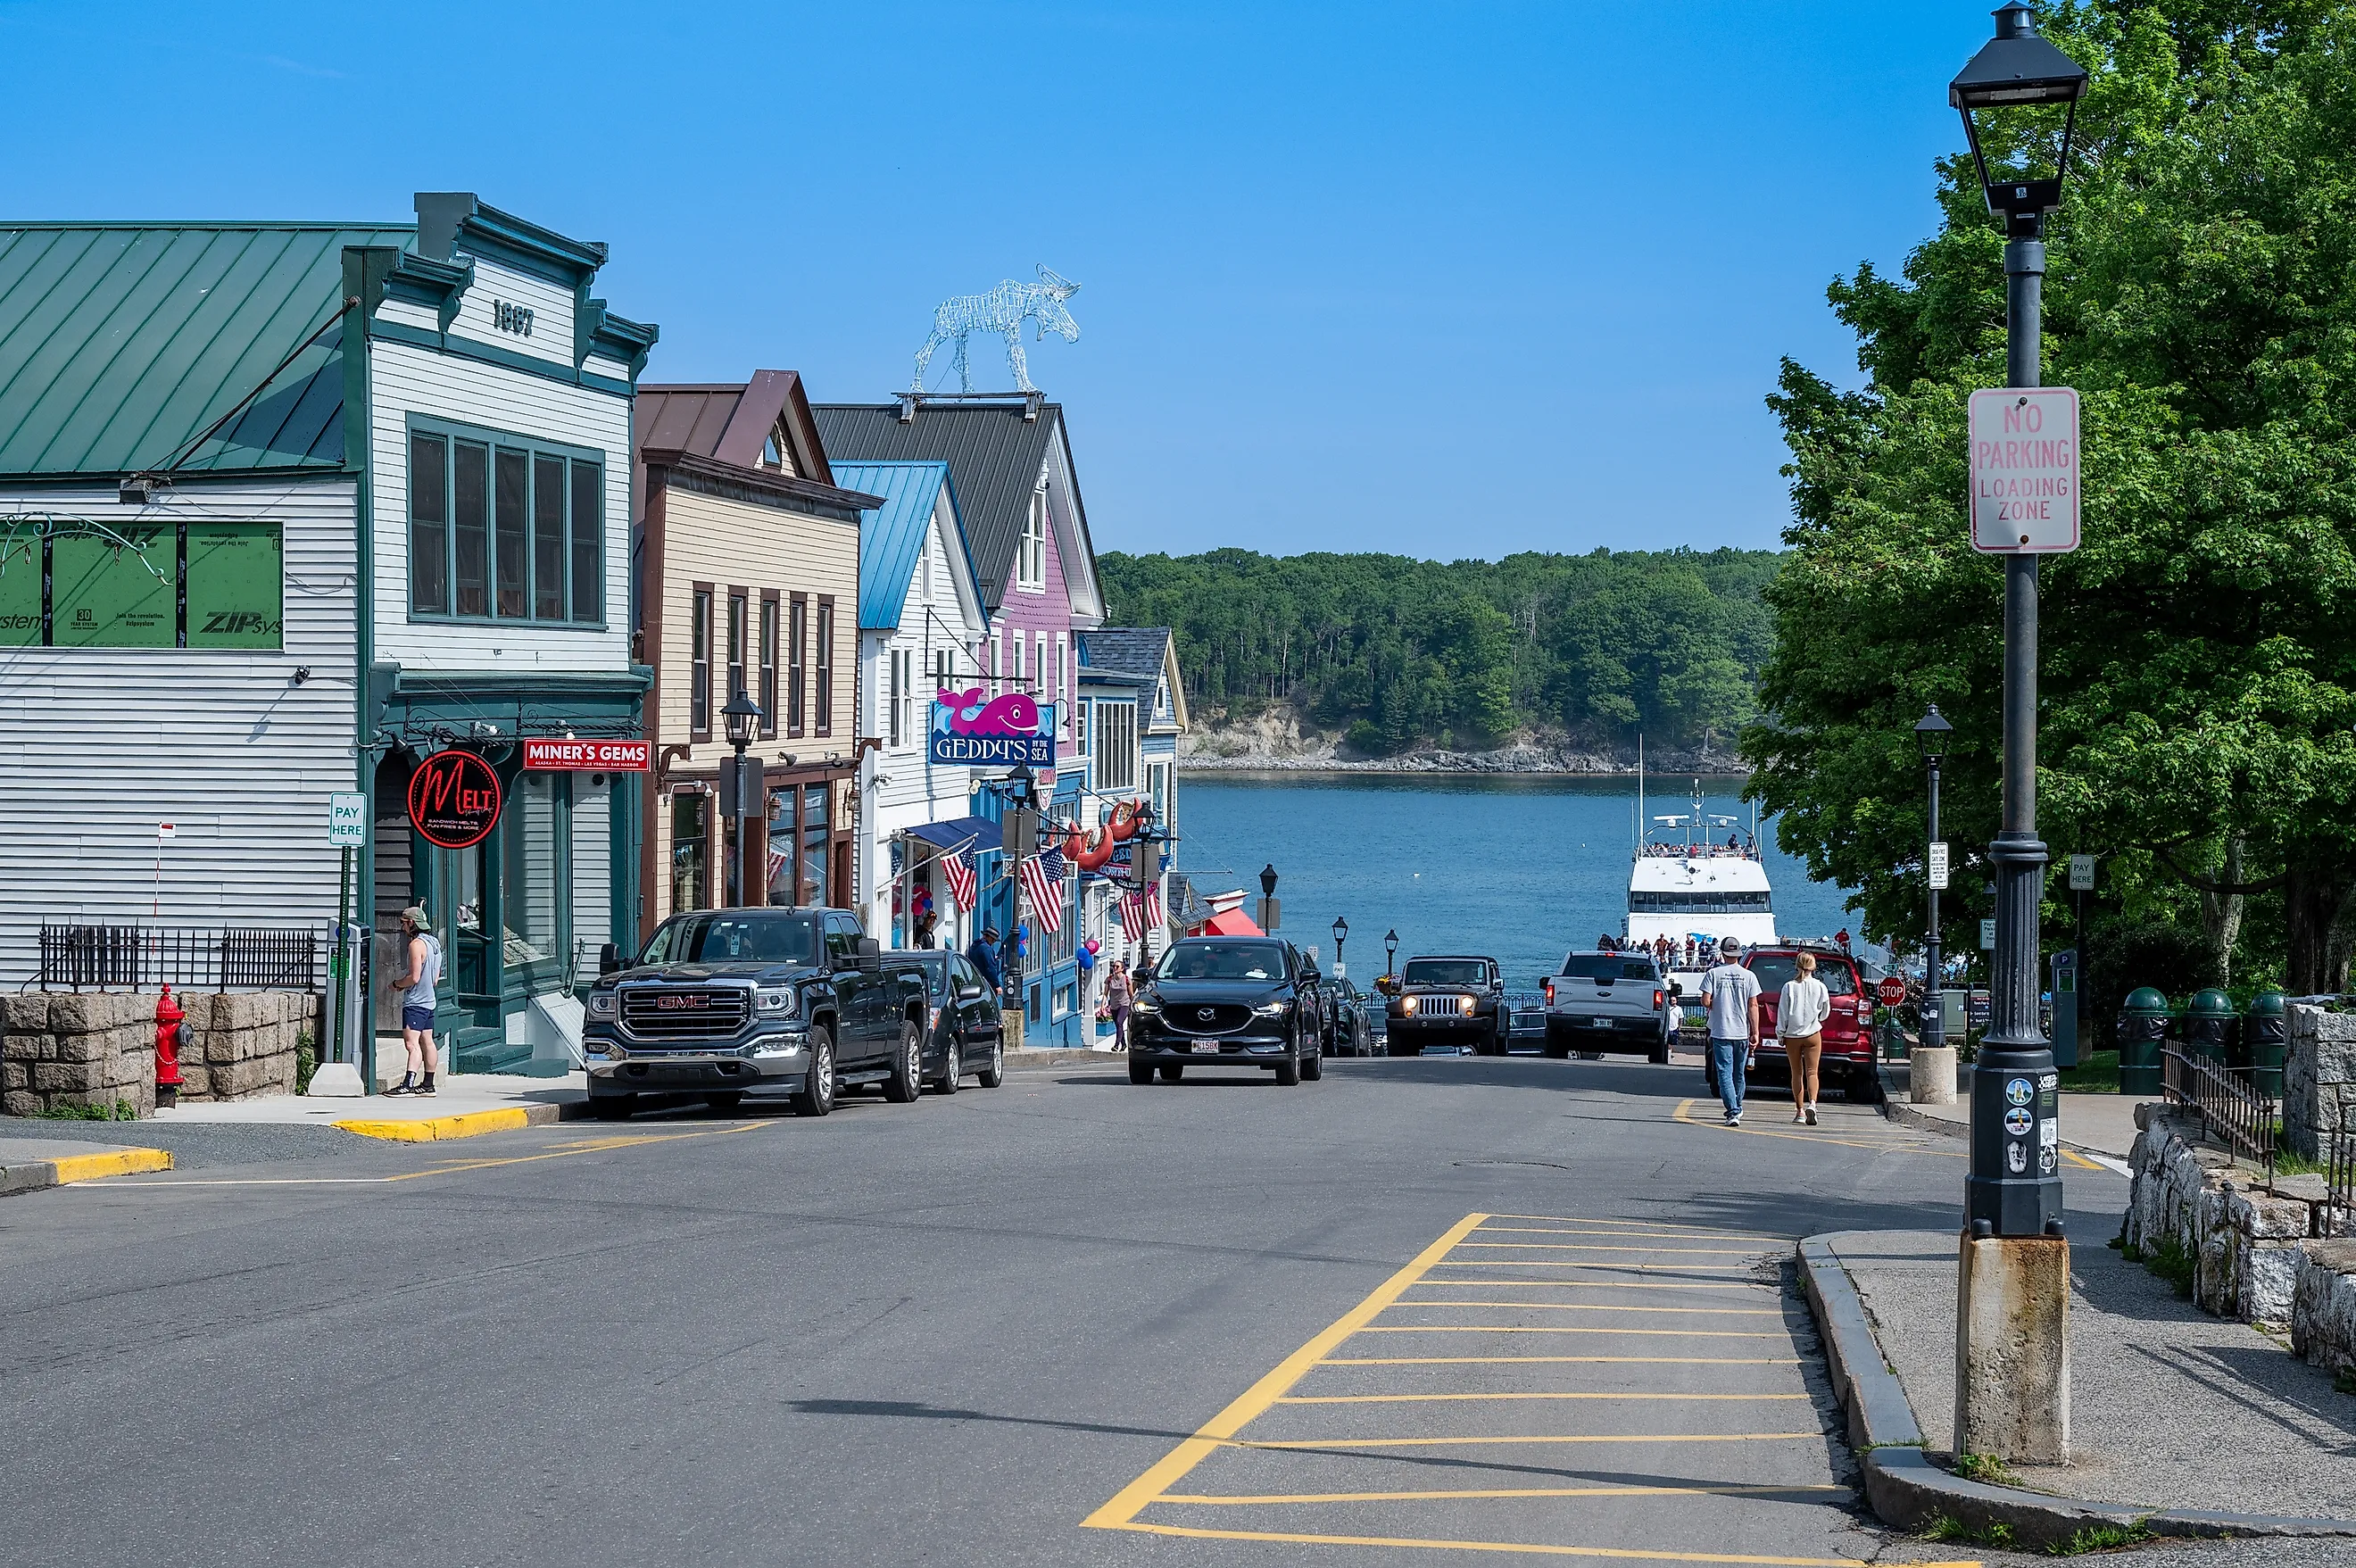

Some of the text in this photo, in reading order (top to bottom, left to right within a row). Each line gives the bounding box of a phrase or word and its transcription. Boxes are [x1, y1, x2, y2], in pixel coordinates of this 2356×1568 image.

[494, 299, 535, 338] 1887
[2004, 403, 2043, 434] NO
[1979, 439, 2070, 469] PARKING
[1980, 477, 2068, 498] LOADING
[1998, 500, 2051, 520] ZONE
[79, 610, 90, 620] 30
[529, 743, 645, 761] MINER'S GEMS
[936, 738, 1027, 760] GEDDY'S
[1031, 748, 1048, 761] SEA
[418, 759, 492, 823] MELT
[336, 807, 359, 818] PAY
[333, 825, 361, 836] HERE
[2073, 864, 2090, 872] PAY
[2072, 875, 2092, 884] HERE
[2062, 956, 2068, 964] P
[1879, 985, 1904, 998] STOP
[658, 995, 709, 1009] GMC
